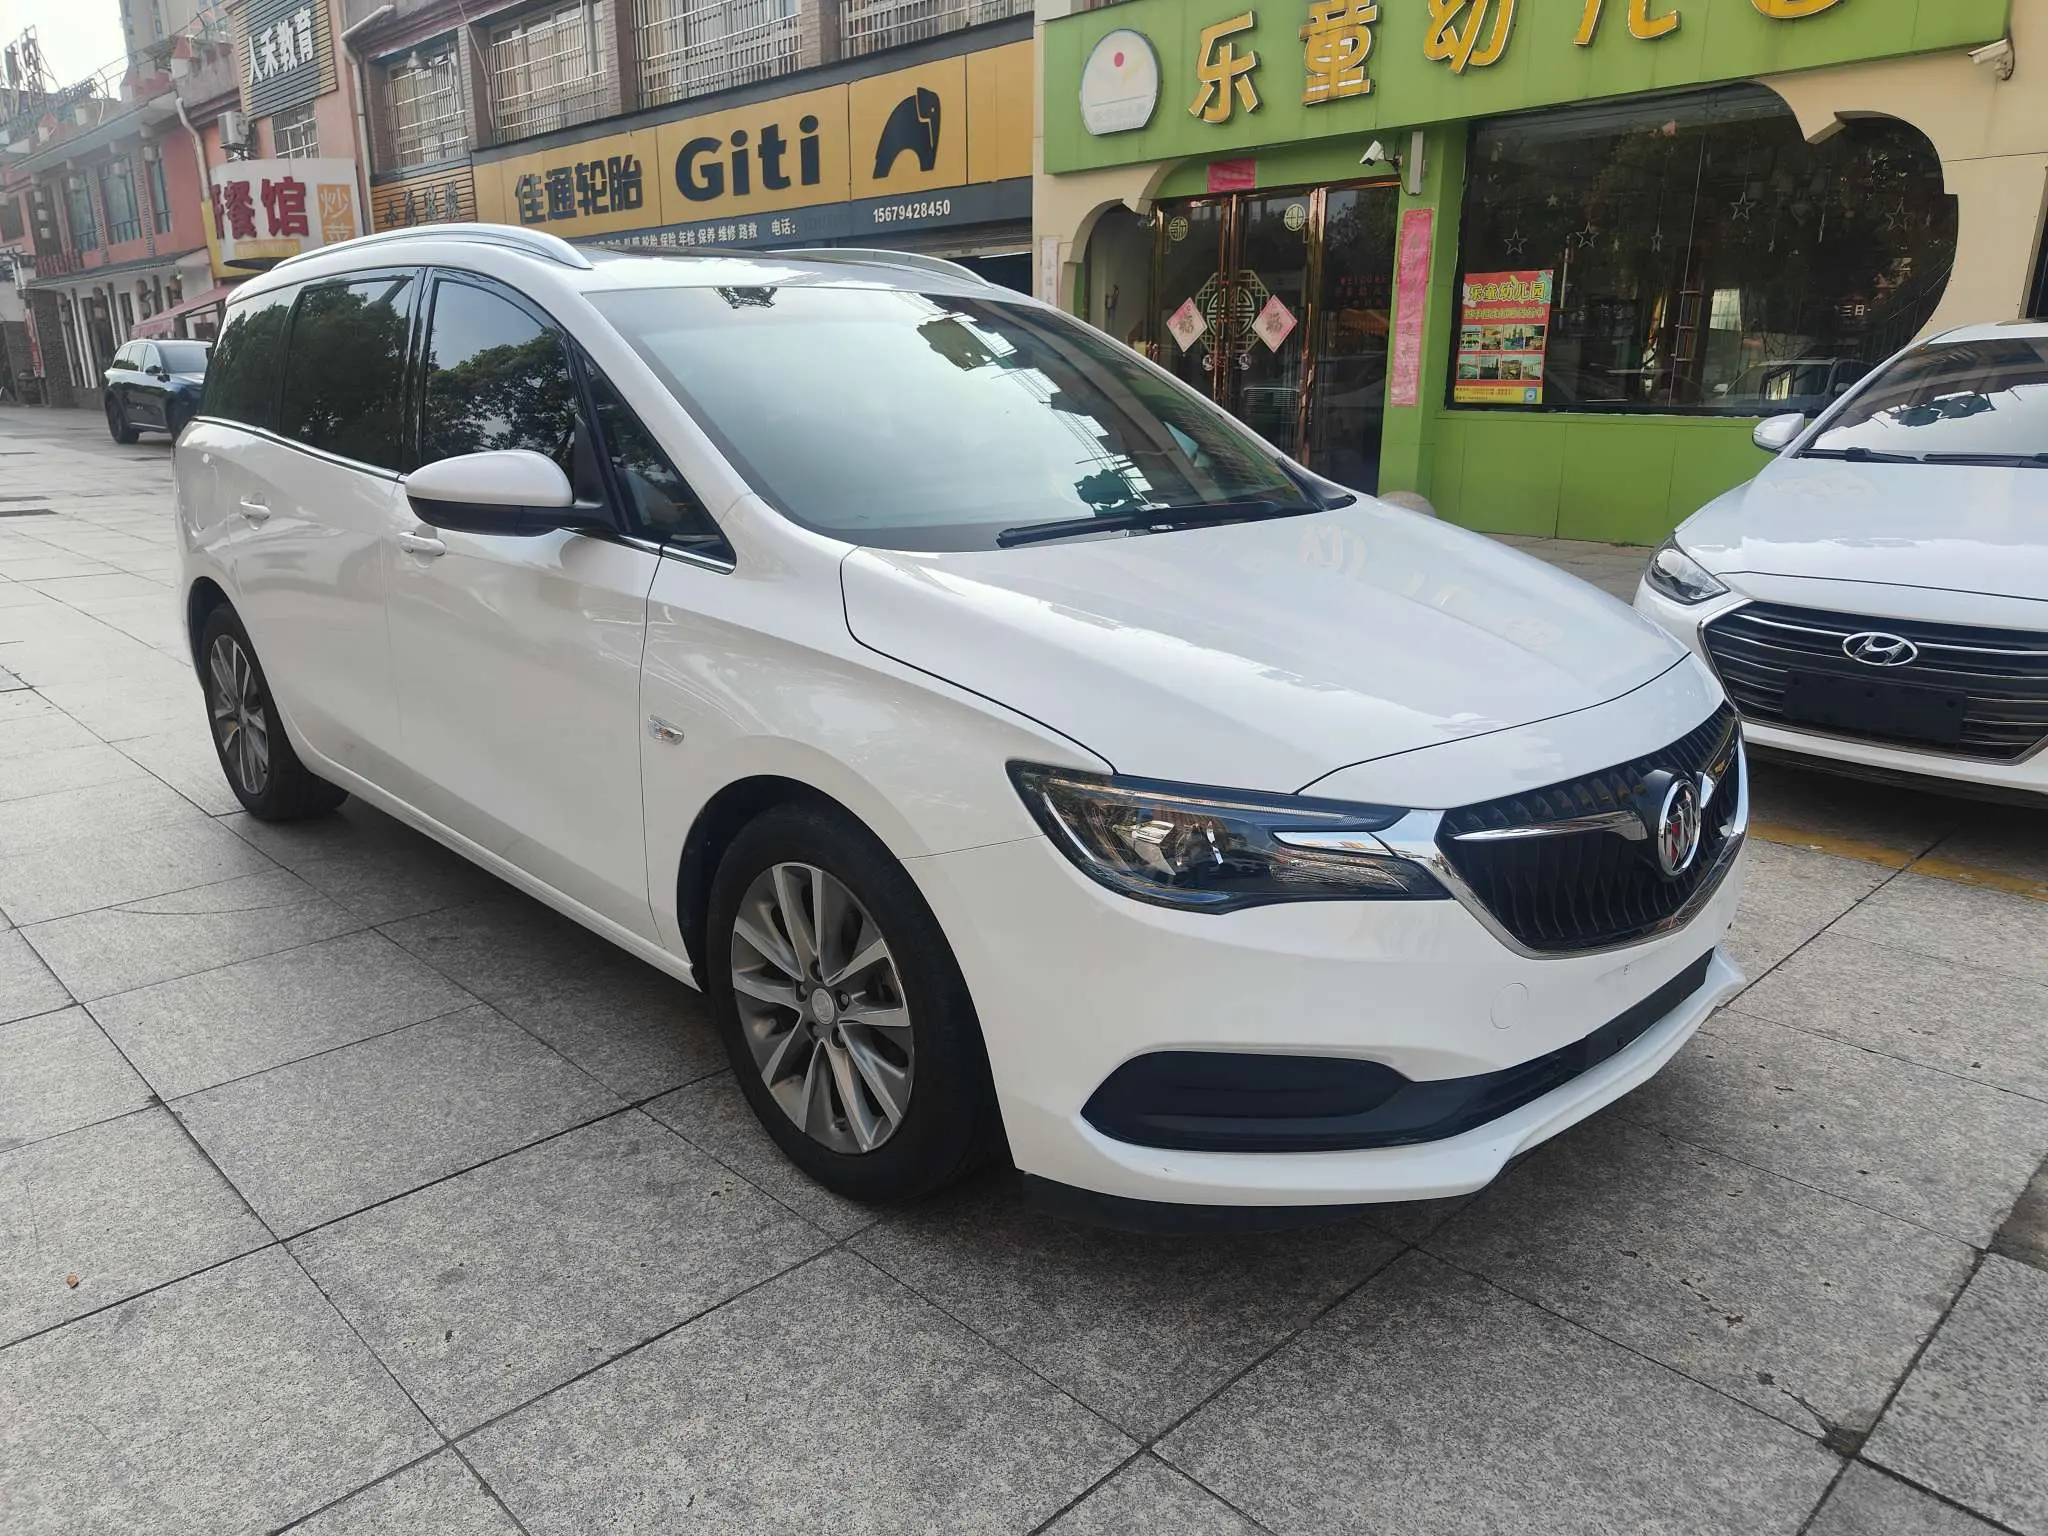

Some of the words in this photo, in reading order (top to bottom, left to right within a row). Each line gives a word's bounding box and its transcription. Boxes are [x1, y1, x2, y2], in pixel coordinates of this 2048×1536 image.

[1188, 0, 1844, 124] 乐童幼
[675, 115, 820, 202] Giti
[515, 154, 643, 225] 佳通轮胎
[873, 200, 951, 223] 15679428450
[678, 229, 696, 246] 年检
[698, 227, 716, 244] 保养
[718, 225, 736, 242] 维修
[1469, 281, 1546, 302] 乐童幼儿园
